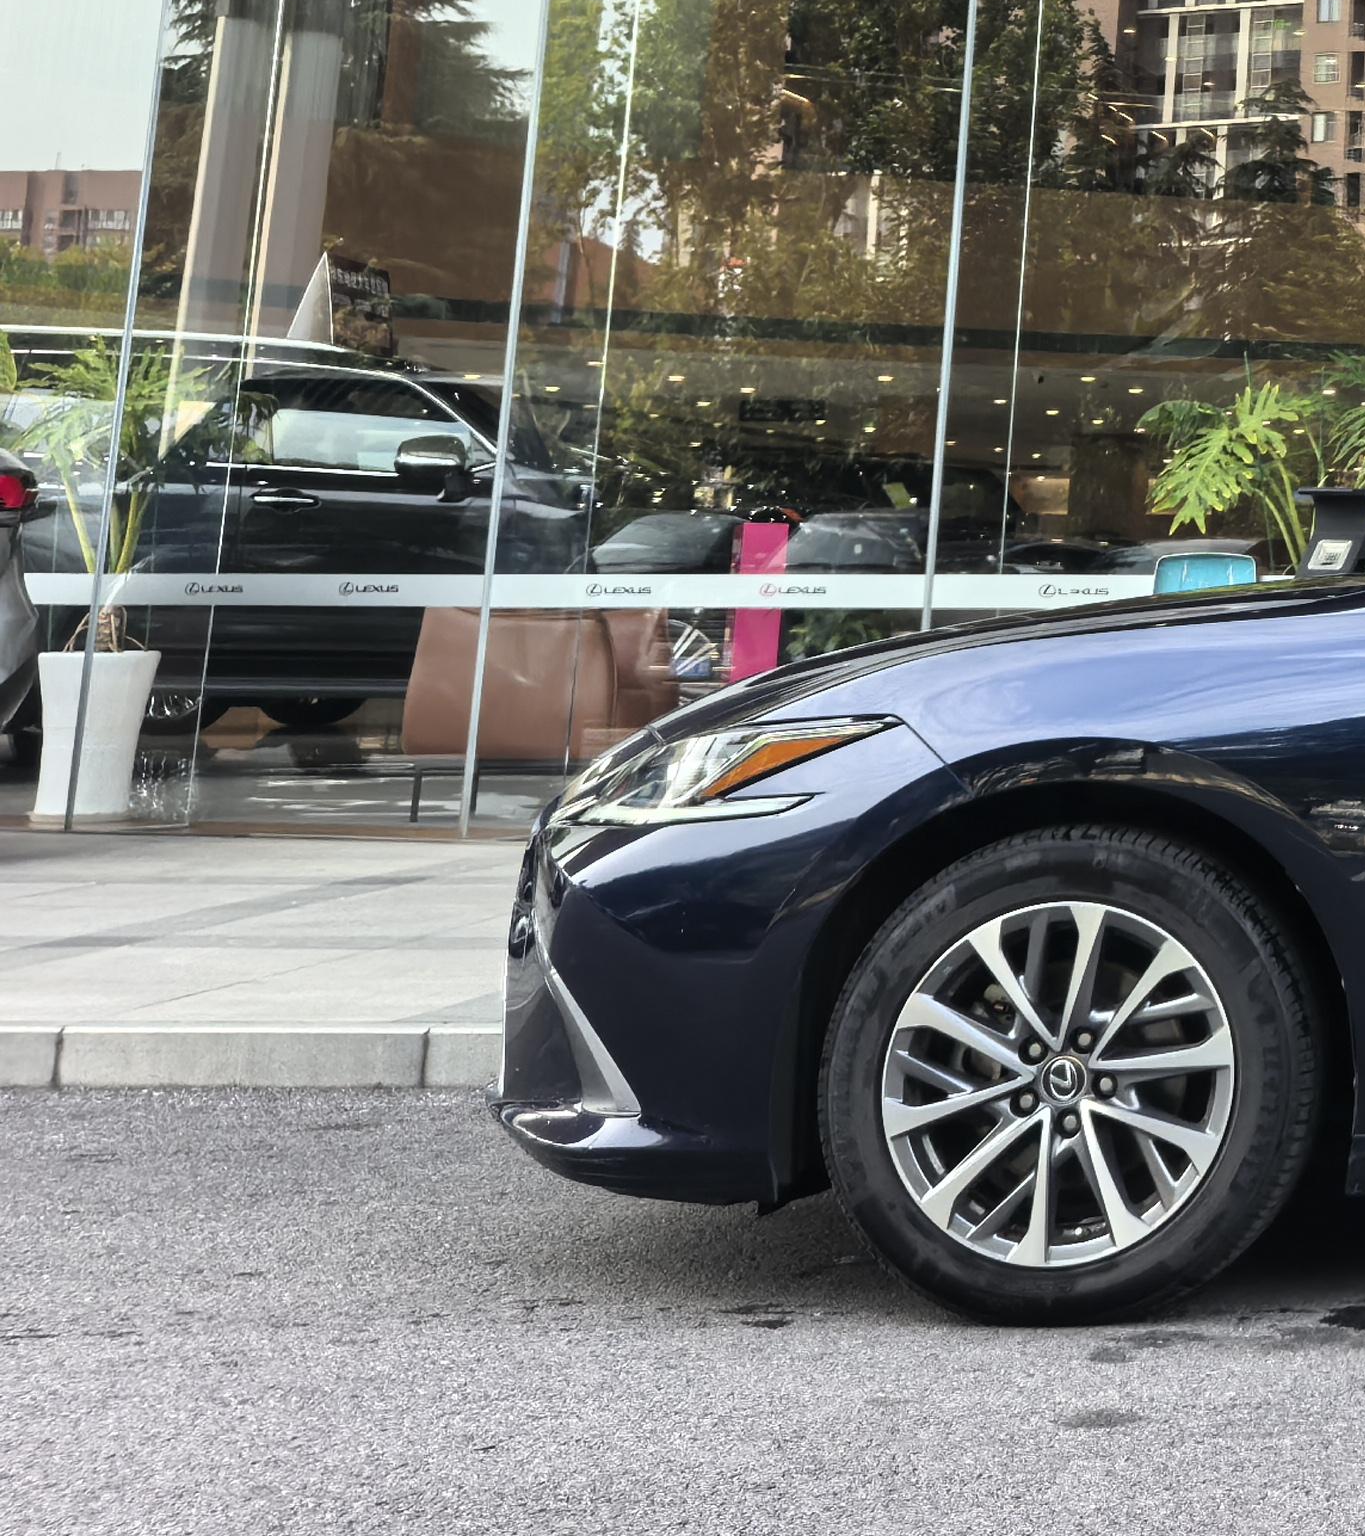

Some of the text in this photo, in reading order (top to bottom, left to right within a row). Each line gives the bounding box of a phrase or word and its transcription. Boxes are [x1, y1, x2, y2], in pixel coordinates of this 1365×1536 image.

[201, 584, 243, 594] LEXUS
[355, 584, 399, 593] LEXUS
[604, 586, 652, 594] LEXUS
[778, 586, 827, 594] LEXUS
